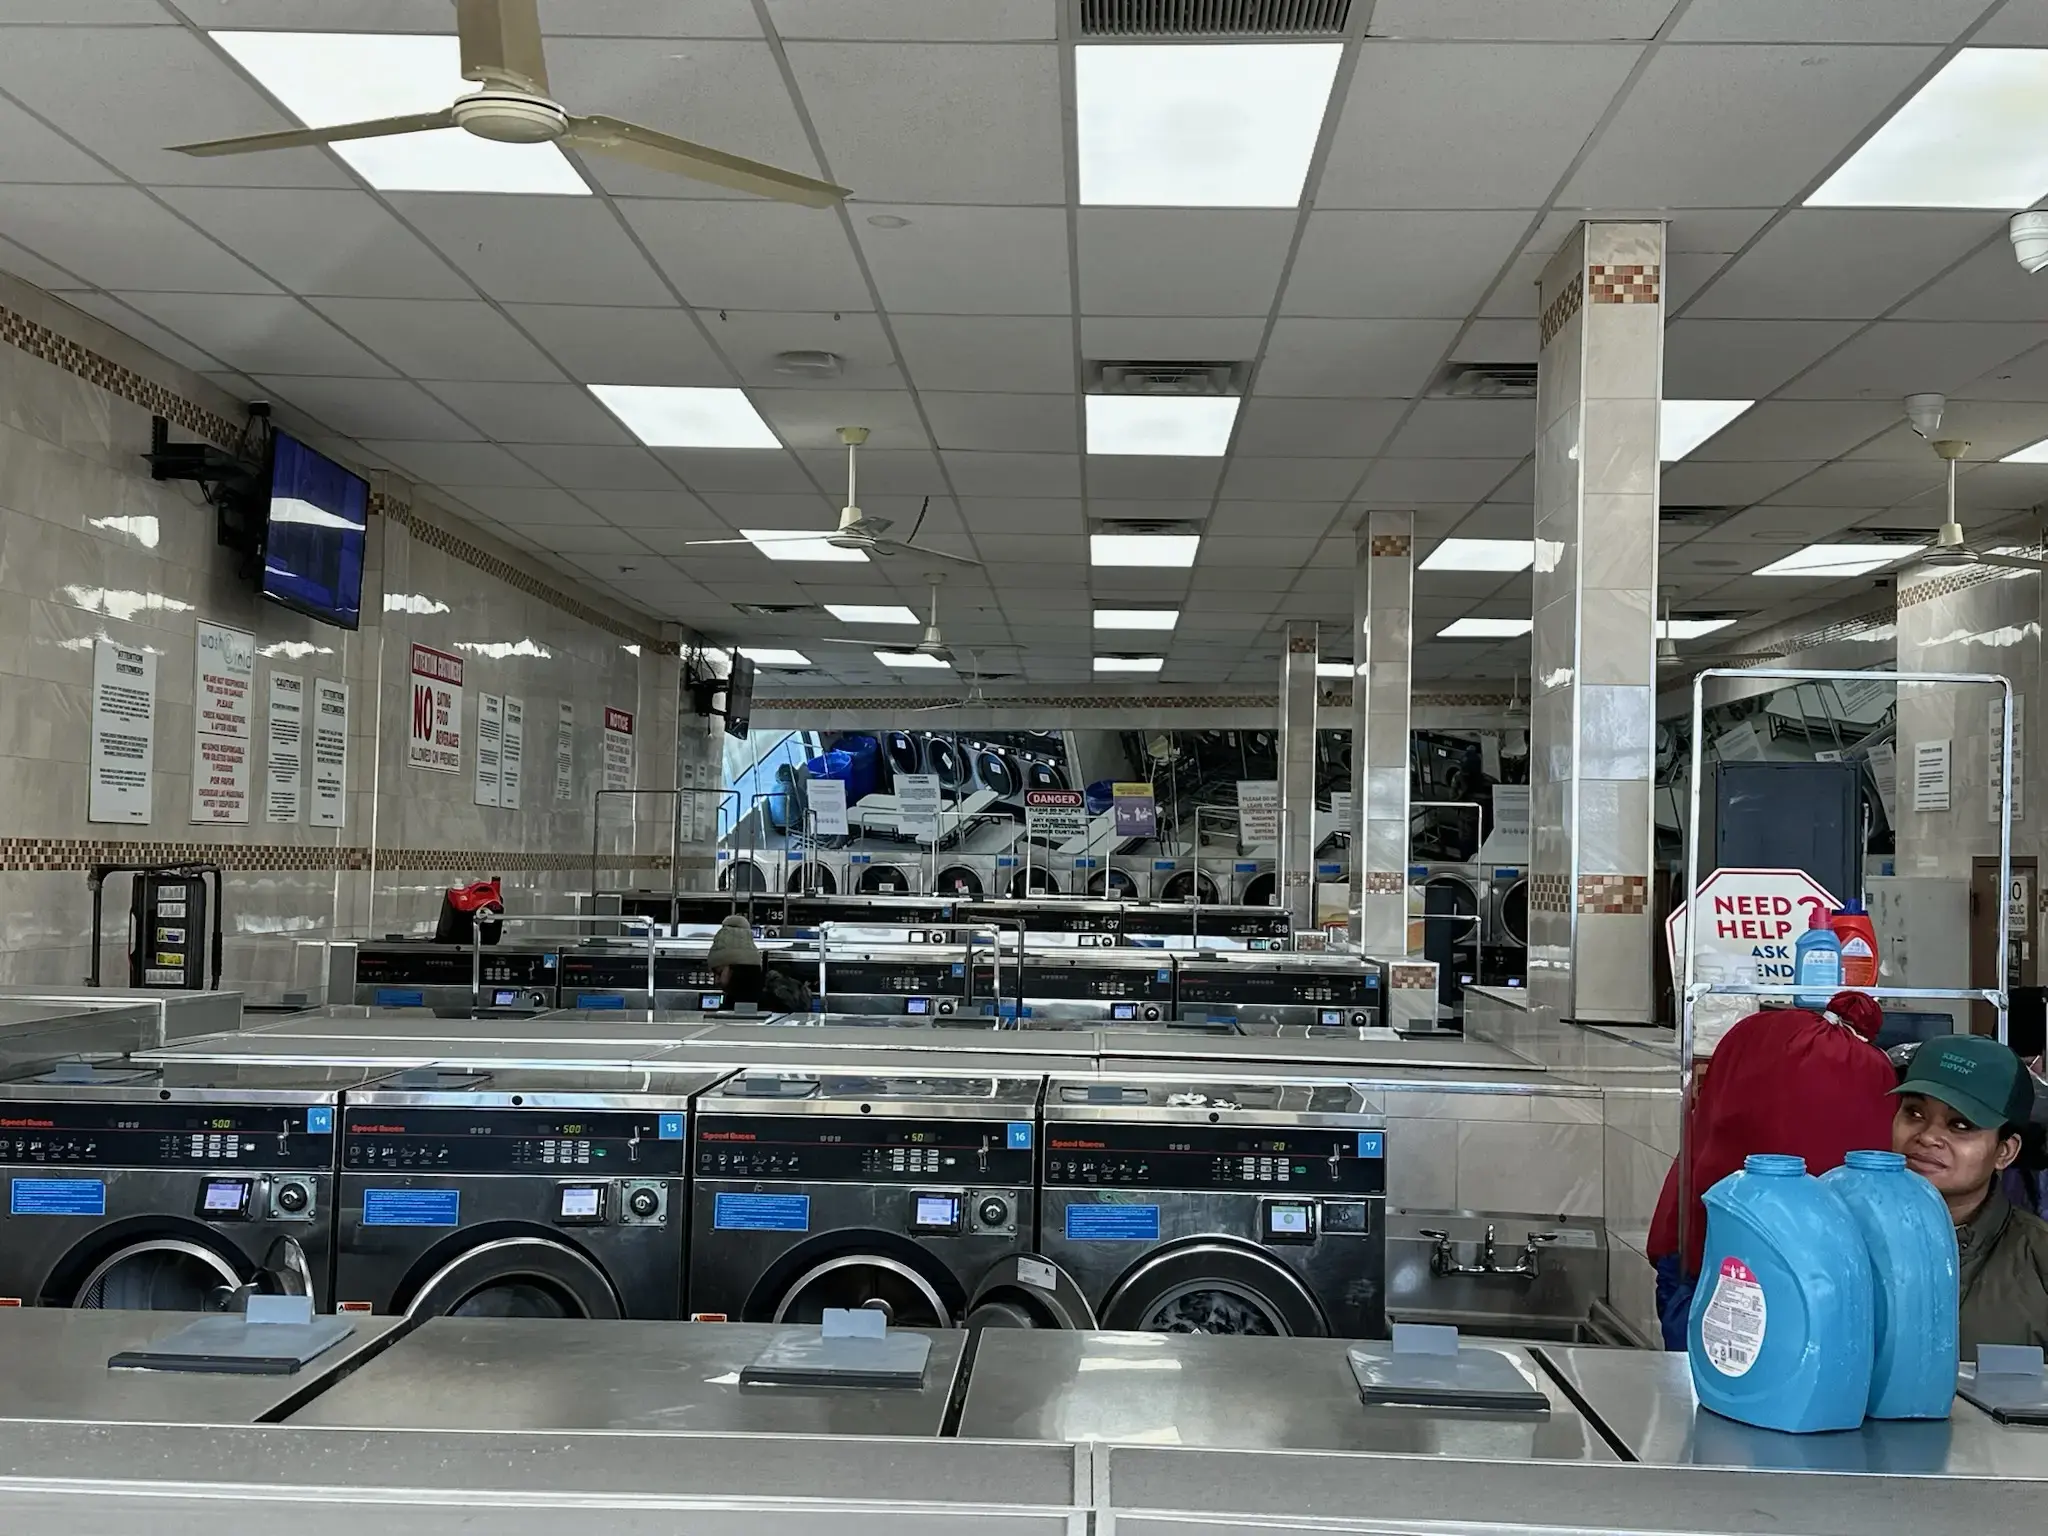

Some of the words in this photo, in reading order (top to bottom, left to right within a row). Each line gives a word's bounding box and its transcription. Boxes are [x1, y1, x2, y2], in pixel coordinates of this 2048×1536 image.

[413, 684, 433, 741] NO
[609, 711, 629, 731] NOTICE
[1032, 794, 1076, 804] DANGER
[1714, 895, 1792, 916] NEED
[771, 911, 784, 920] 35
[1107, 919, 1120, 930] 37
[1275, 924, 1288, 934] 38
[1716, 919, 1792, 940] HELP
[1751, 945, 1789, 959] ASK
[1942, 1052, 1966, 1064] KEEP
[1966, 1060, 1977, 1069] IT
[0, 1118, 27, 1127] Speed
[27, 1118, 54, 1127] Queen
[211, 1119, 231, 1129] 500
[315, 1115, 326, 1125] 14
[351, 1124, 378, 1133] Speed
[378, 1124, 405, 1133] Queen
[563, 1124, 581, 1134] 500
[666, 1123, 678, 1132] 15
[702, 1131, 729, 1140] Speed
[729, 1132, 756, 1140] Queen
[911, 1132, 924, 1142] 50
[1015, 1132, 1026, 1141] 16
[1051, 1139, 1078, 1148] Speed
[1078, 1140, 1105, 1148] Queen
[1272, 1141, 1285, 1151] 20
[1365, 1141, 1377, 1151] 17
